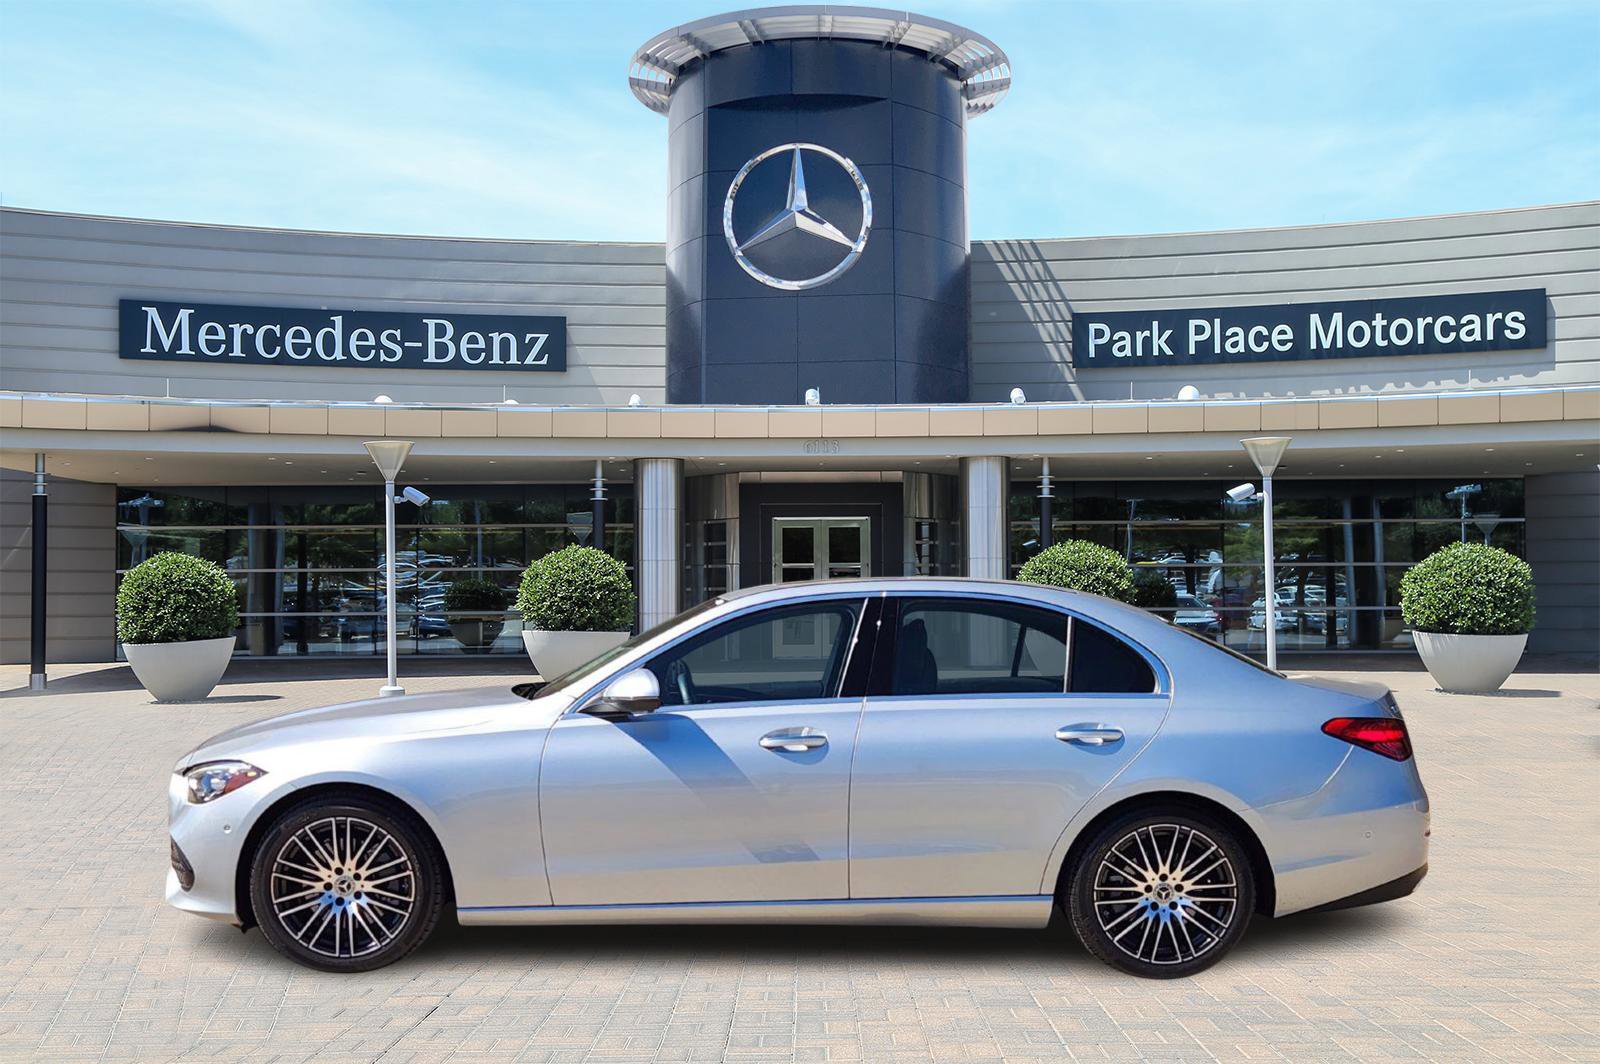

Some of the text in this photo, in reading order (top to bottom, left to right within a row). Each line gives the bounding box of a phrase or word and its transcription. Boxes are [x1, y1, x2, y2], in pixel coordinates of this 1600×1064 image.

[140, 306, 550, 365] Mercedes-Benz
[1087, 309, 1527, 358] Park Place Motorcars
